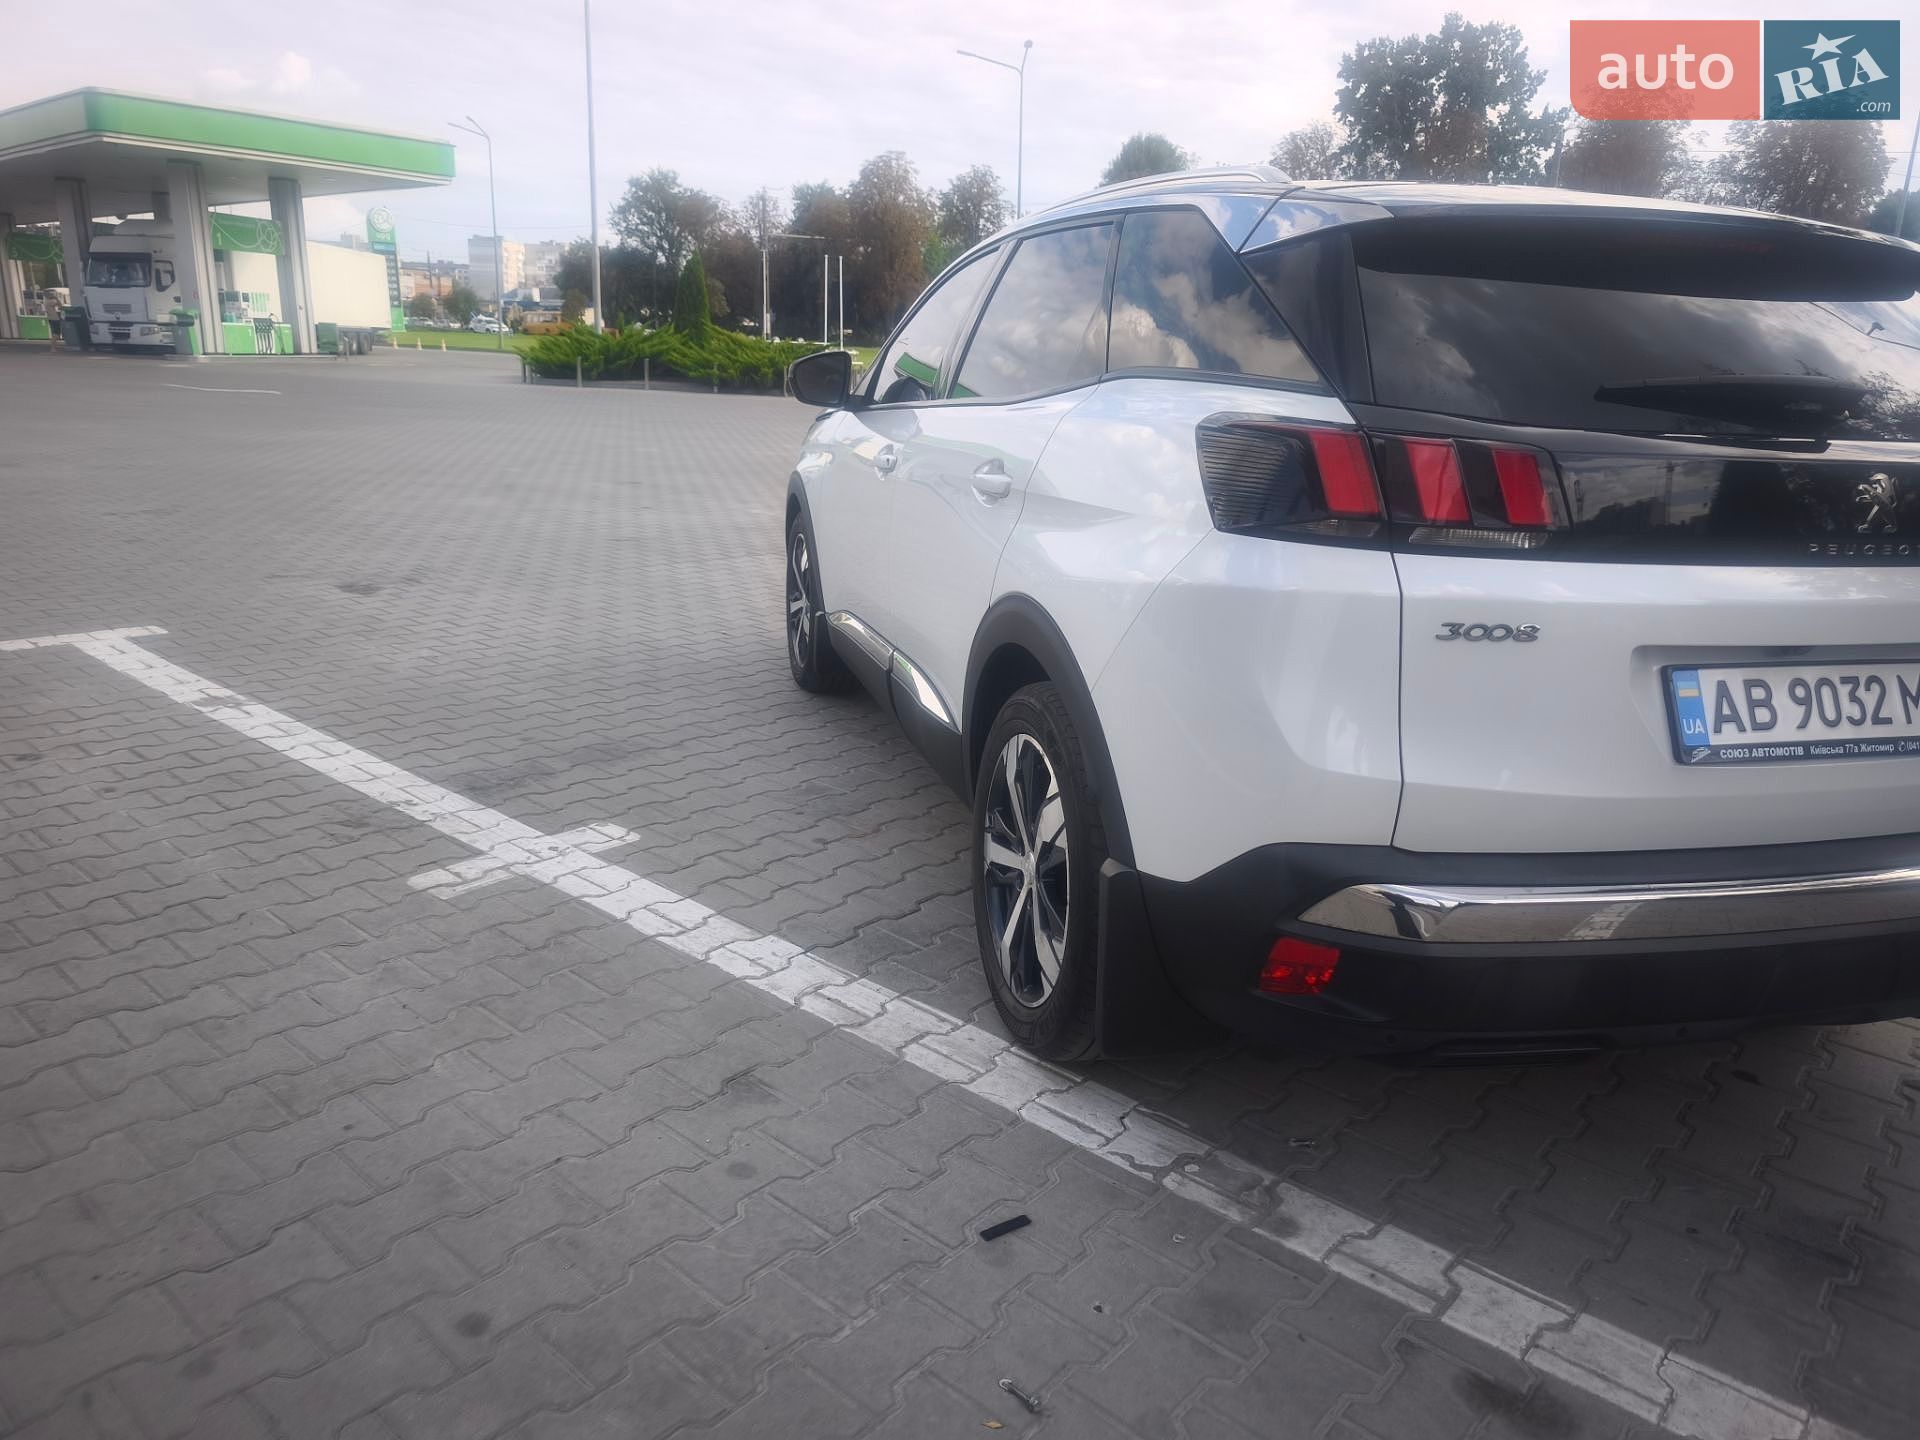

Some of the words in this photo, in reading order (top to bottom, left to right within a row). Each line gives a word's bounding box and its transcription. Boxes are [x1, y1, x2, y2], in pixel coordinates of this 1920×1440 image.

[1435, 622, 1541, 642] 3008
[1713, 679, 1778, 733] AB
[1788, 674, 1893, 730] 9032
[1682, 719, 1705, 734] UA
[1720, 748, 1750, 758] СОЮЗ
[1752, 746, 1804, 757] АВТОМОТІВ
[1860, 743, 1895, 753] Житомир
